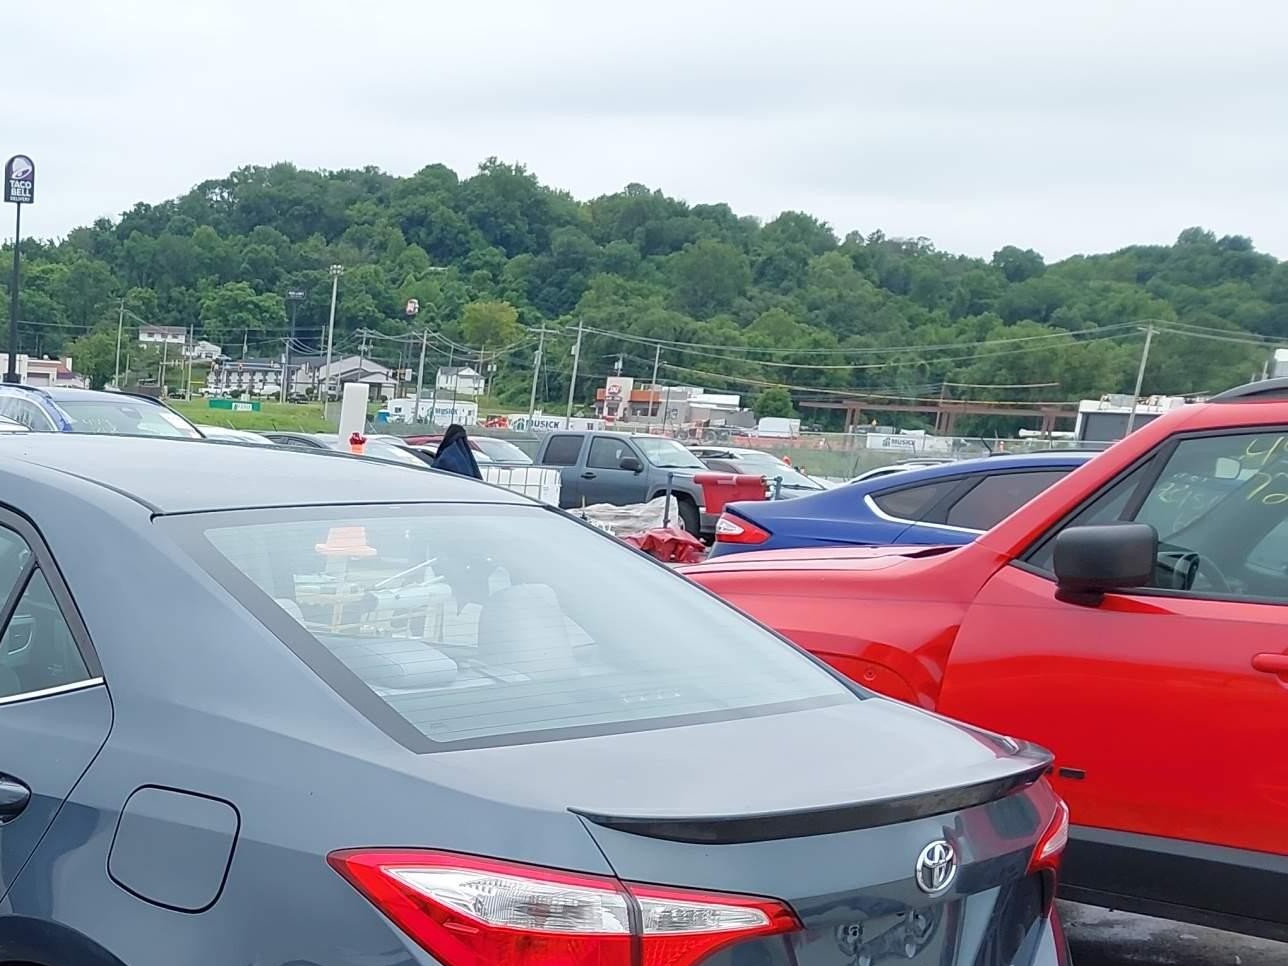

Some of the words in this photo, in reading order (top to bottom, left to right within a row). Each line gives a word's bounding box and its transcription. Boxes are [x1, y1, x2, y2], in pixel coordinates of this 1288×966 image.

[9, 180, 32, 189] TACO
[10, 188, 32, 197] BELL
[526, 419, 560, 429] MUSICK
